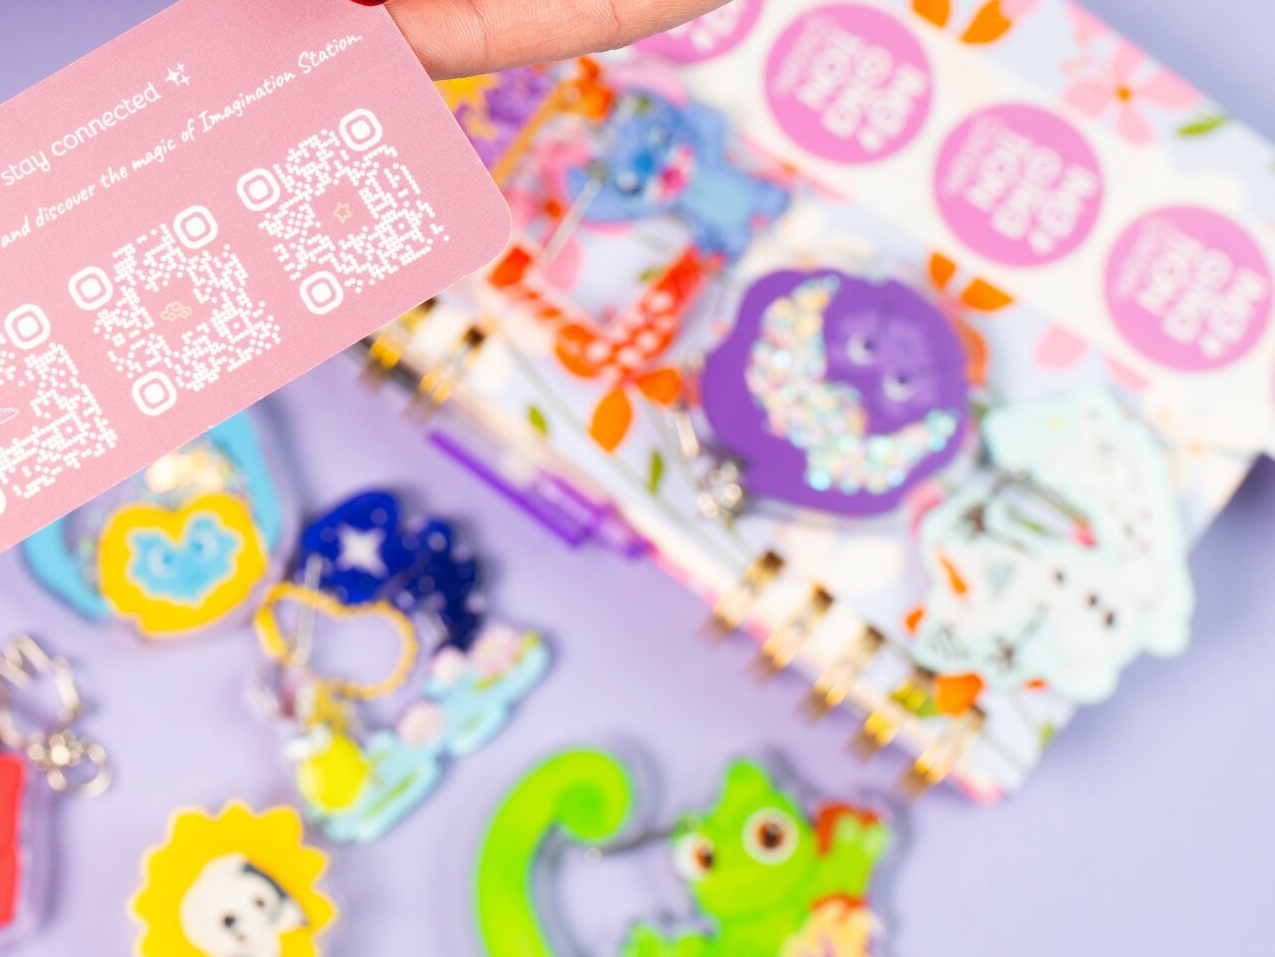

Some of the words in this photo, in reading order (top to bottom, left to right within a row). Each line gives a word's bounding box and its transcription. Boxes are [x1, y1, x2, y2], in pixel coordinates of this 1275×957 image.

[1, 151, 50, 185] stay
[52, 82, 162, 156] connected
[1, 216, 31, 247] and
[36, 185, 96, 227] discover
[100, 166, 128, 188] the
[132, 139, 176, 170] magic
[181, 118, 195, 142] of
[198, 72, 295, 132] Imagination
[298, 35, 362, 74] Station.
